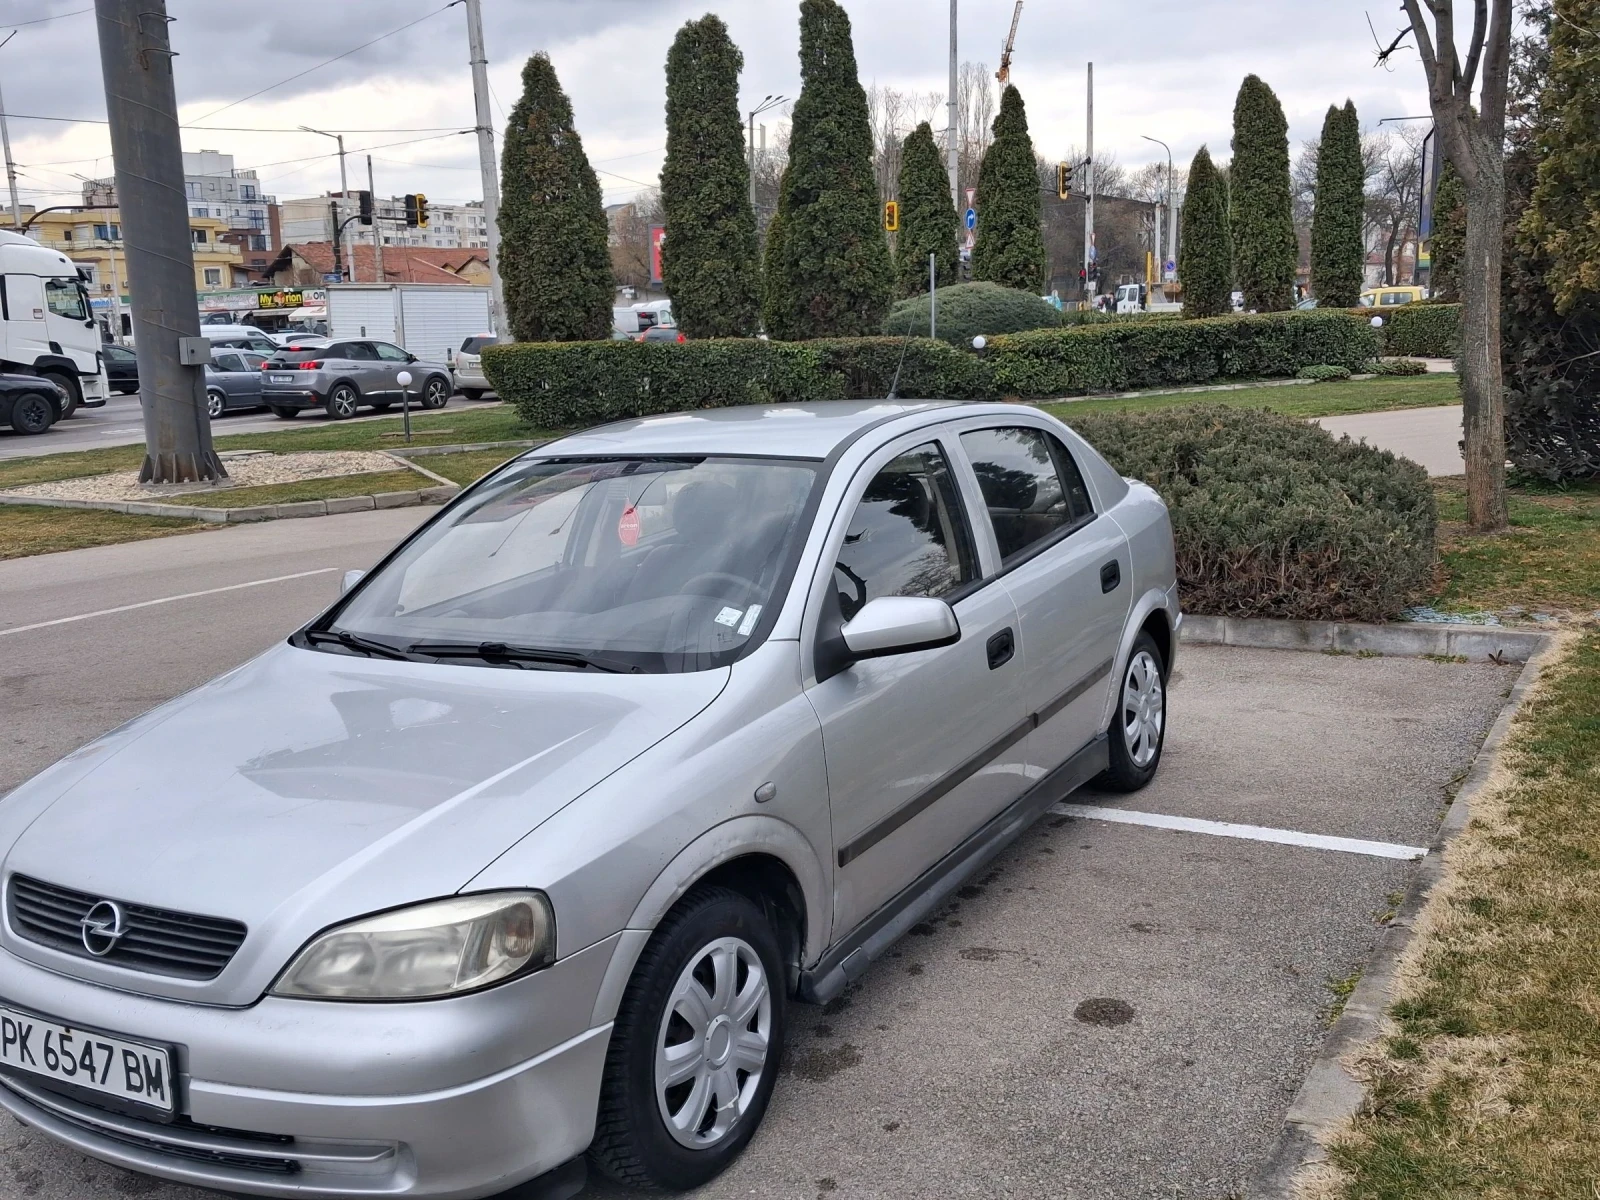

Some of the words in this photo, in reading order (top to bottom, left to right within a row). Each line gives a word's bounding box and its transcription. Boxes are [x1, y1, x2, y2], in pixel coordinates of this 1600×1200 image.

[260, 294, 272, 304] My
[1, 1015, 37, 1066] PK
[43, 1029, 114, 1085] 6547
[121, 1048, 166, 1102] BM
